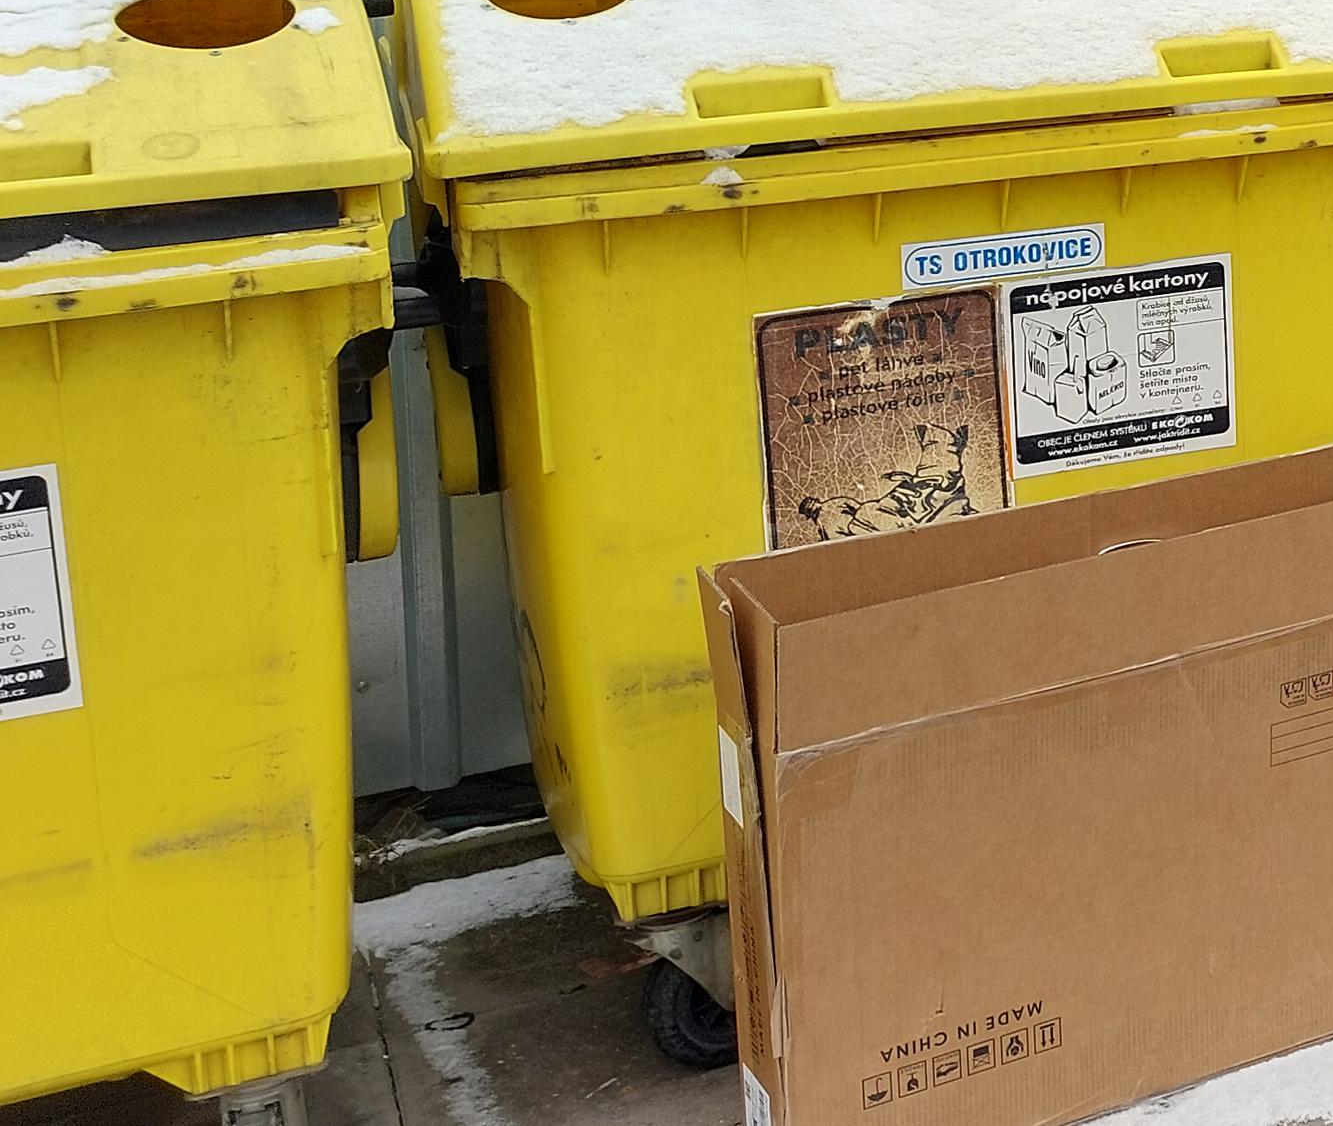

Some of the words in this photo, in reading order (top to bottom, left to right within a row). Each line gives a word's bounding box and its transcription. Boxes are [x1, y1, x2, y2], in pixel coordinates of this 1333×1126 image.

[915, 255, 942, 276] TS
[954, 237, 1091, 272] OTROKOVICE
[1026, 277, 1125, 309] nápojové
[1129, 272, 1209, 293] kartony
[1173, 298, 1183, 306] od
[794, 308, 964, 358] PLASTY
[1073, 429, 1108, 442] ČLENEM
[1110, 422, 1147, 437] SYSTÉMU
[1048, 439, 1118, 457] www.ekokom.cz
[957, 1021, 977, 1040] IN
[986, 1000, 1043, 1031] MADE
[880, 1031, 947, 1063] CHINA
